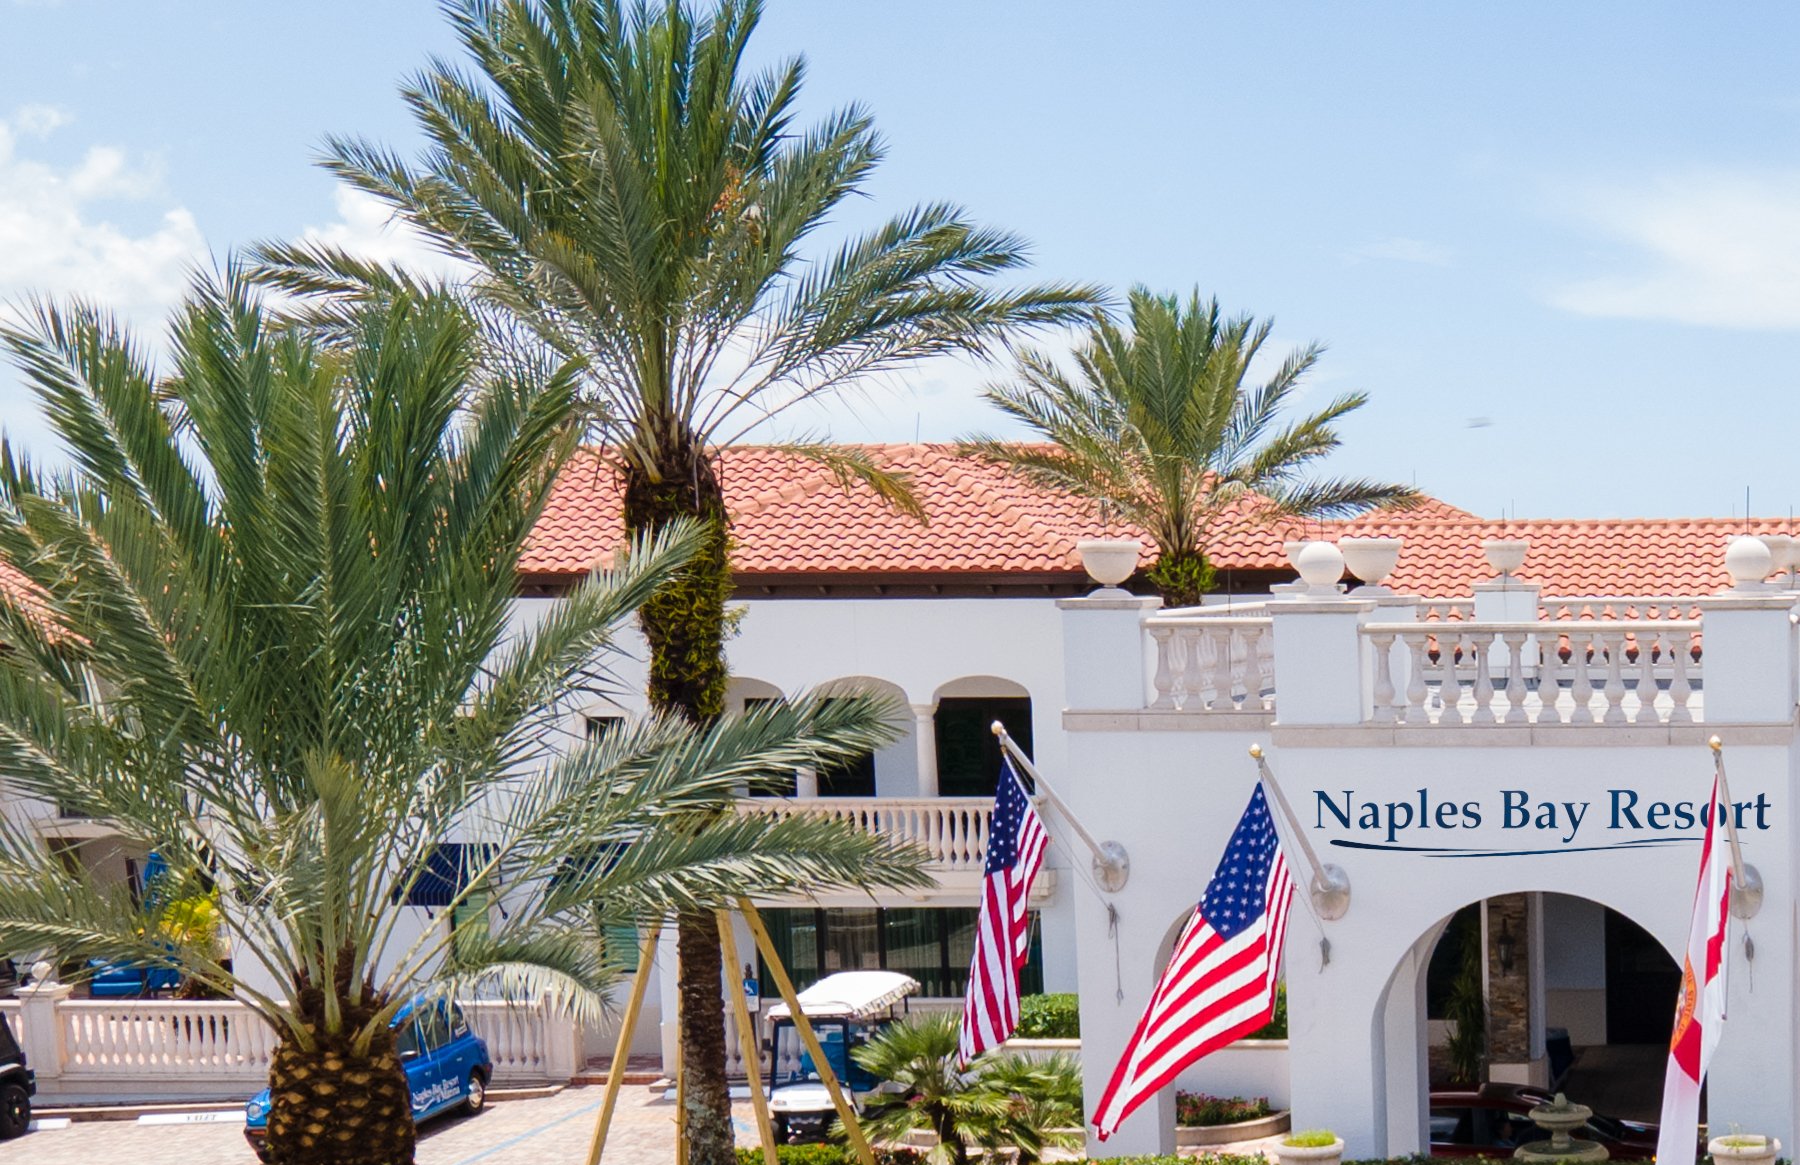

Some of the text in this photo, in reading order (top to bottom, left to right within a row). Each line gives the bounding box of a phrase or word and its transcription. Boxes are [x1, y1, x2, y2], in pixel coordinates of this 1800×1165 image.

[1313, 788, 1772, 843] Naples Bay Resort
